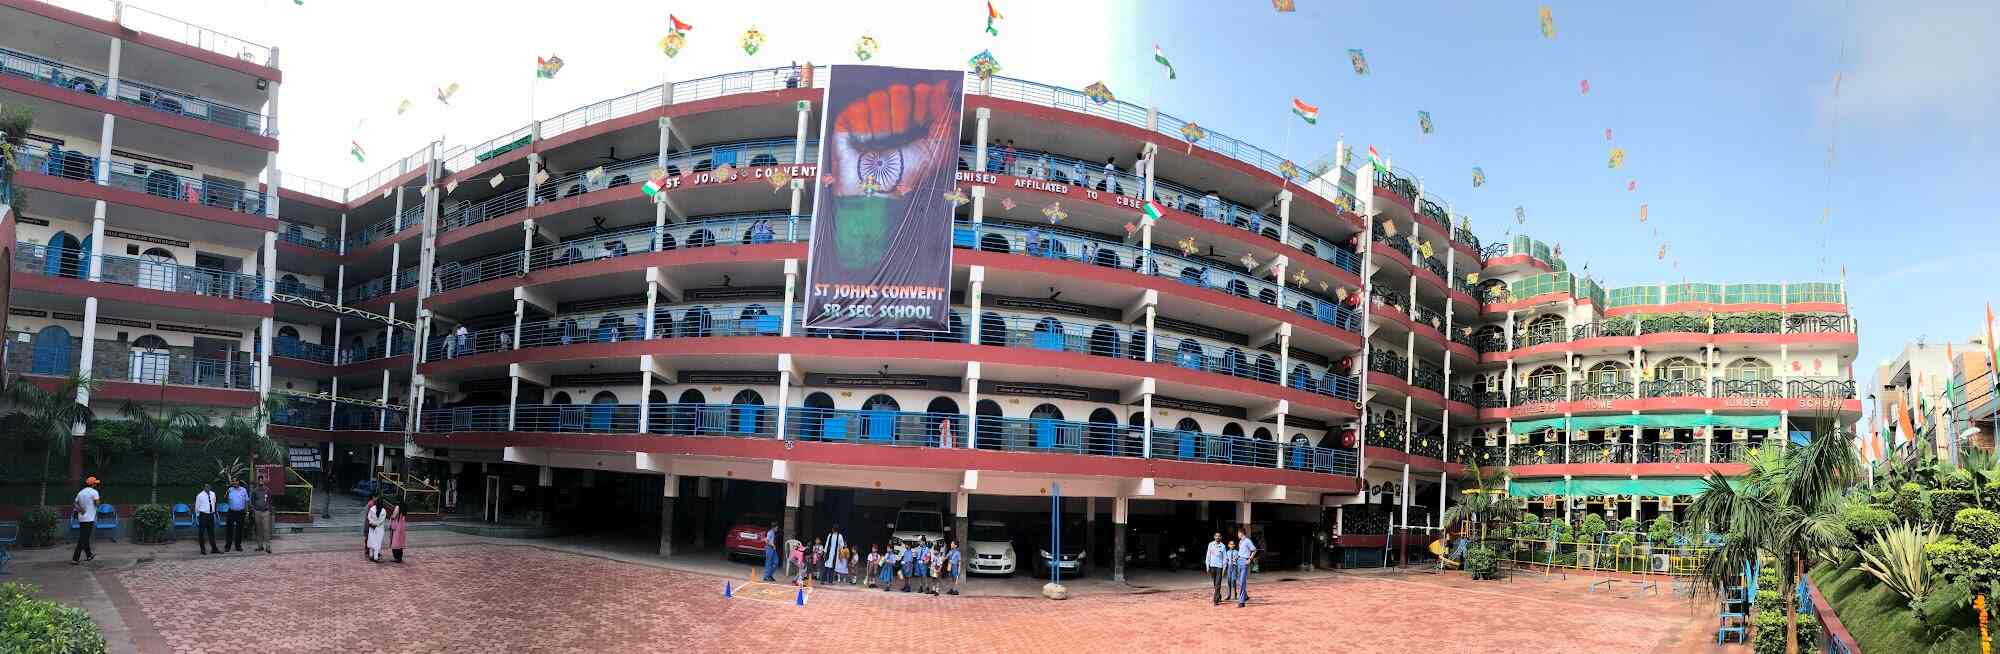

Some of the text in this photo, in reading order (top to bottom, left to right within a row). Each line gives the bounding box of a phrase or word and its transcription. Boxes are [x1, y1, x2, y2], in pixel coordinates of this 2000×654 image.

[755, 166, 817, 178] COVENT
[1014, 178, 1068, 194] AFFILIATED
[1086, 190, 1098, 200] TO
[1116, 196, 1142, 209] CBSE
[814, 283, 945, 301] ST JOHNS CONVENT
[879, 305, 933, 320] SCHOOL
[1585, 399, 1613, 409] HOME
